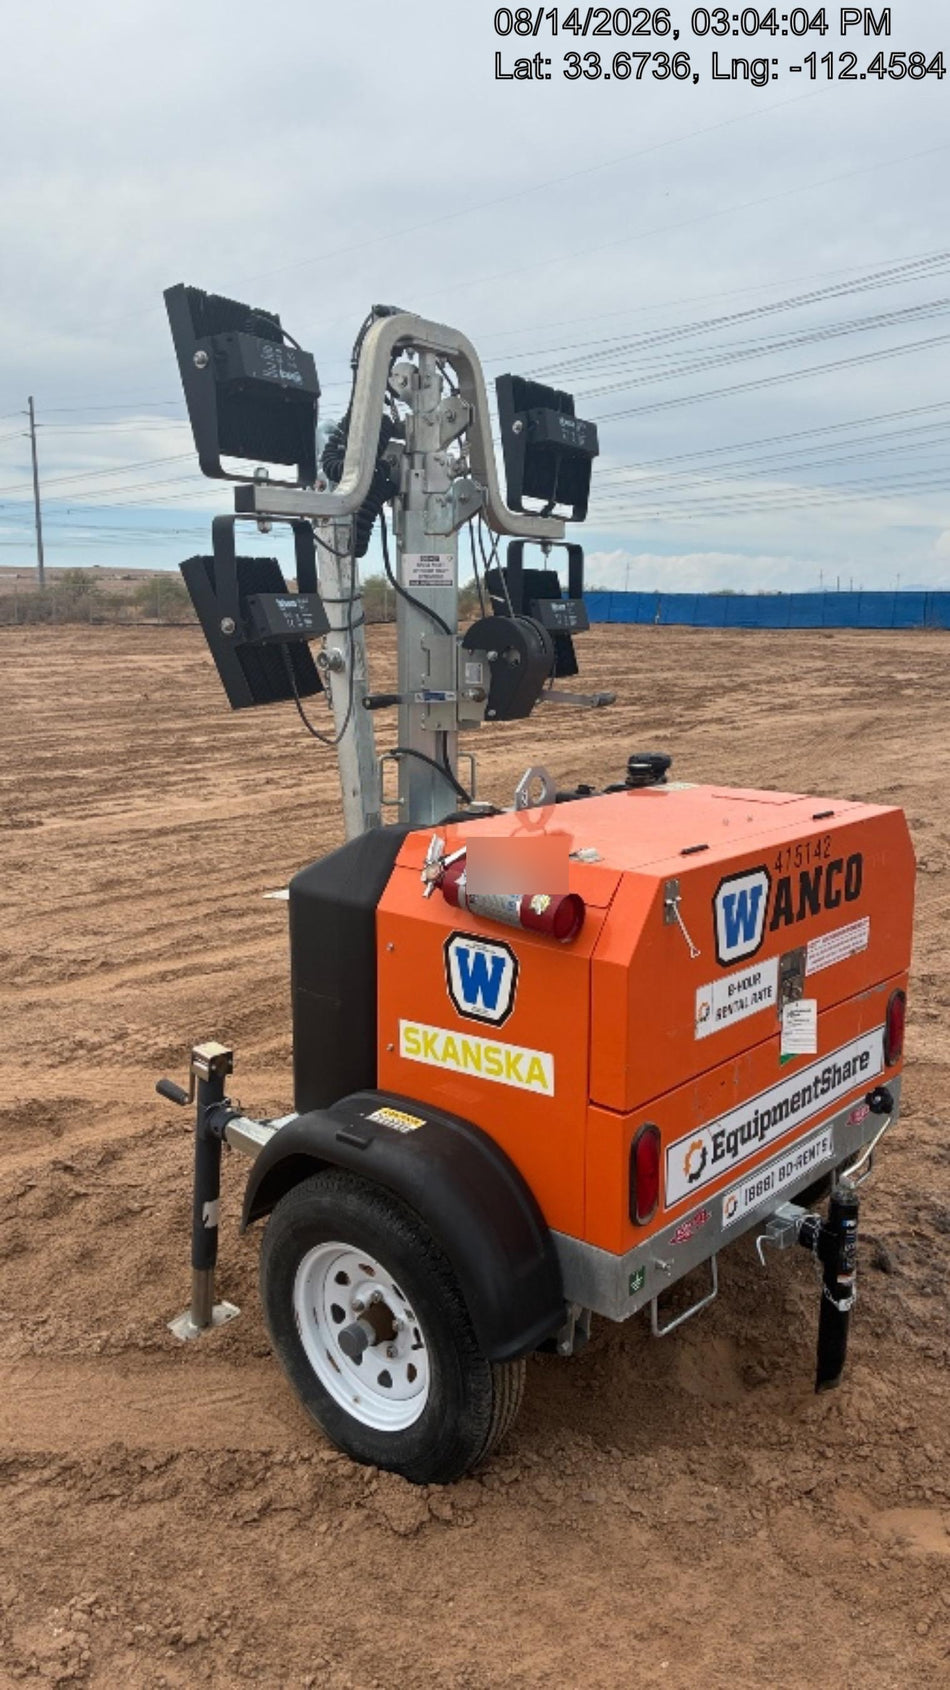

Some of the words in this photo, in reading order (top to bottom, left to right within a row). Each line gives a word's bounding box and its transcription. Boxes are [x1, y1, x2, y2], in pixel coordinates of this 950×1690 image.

[721, 851, 863, 950] WANCO
[716, 996, 748, 1021] RENTAL
[751, 985, 773, 1005] RATE
[403, 1026, 549, 1089] SKANSKA
[711, 1050, 870, 1165] EquipmentShare
